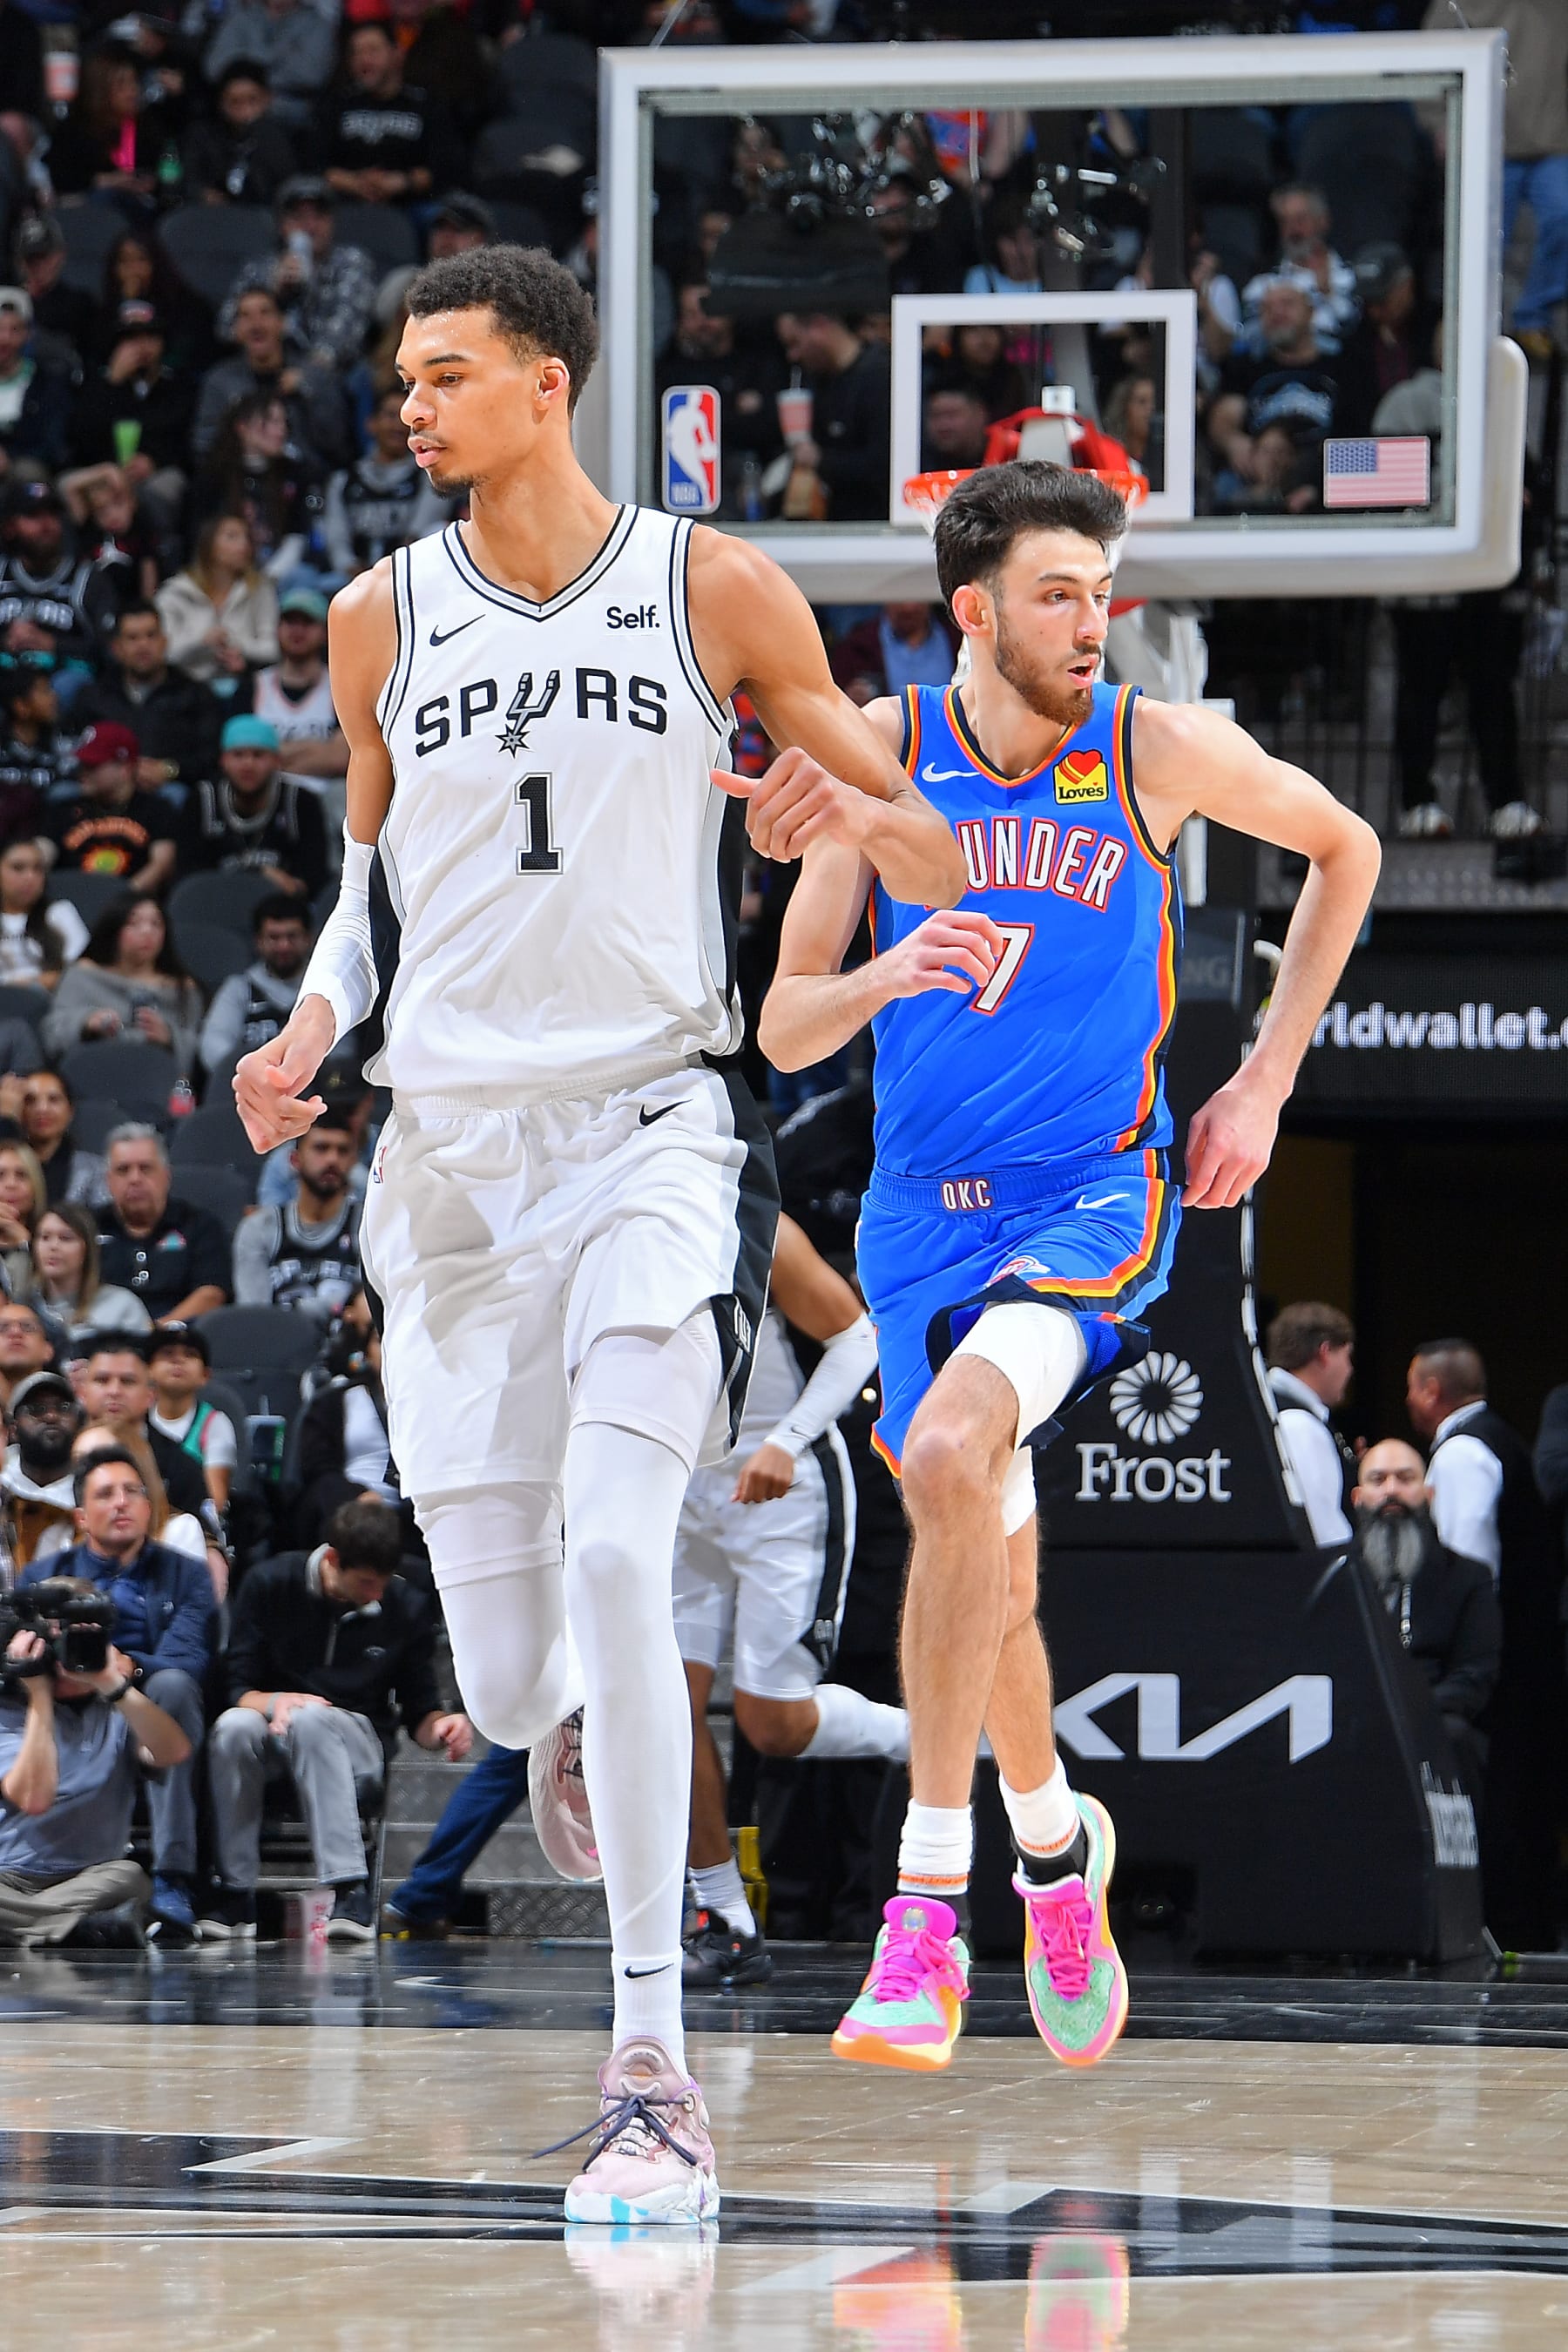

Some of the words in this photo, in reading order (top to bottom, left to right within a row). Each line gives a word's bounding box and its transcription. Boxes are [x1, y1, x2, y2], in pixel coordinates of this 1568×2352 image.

[606, 605, 660, 629] Self.
[416, 667, 667, 758] SPURS
[514, 772, 564, 875] 1
[956, 815, 1129, 913] UNDER
[969, 921, 1036, 1017] 7
[1311, 1002, 1568, 1049] rldwallet.
[942, 1179, 991, 1211] OKC
[1075, 1443, 1233, 1503] Frost
